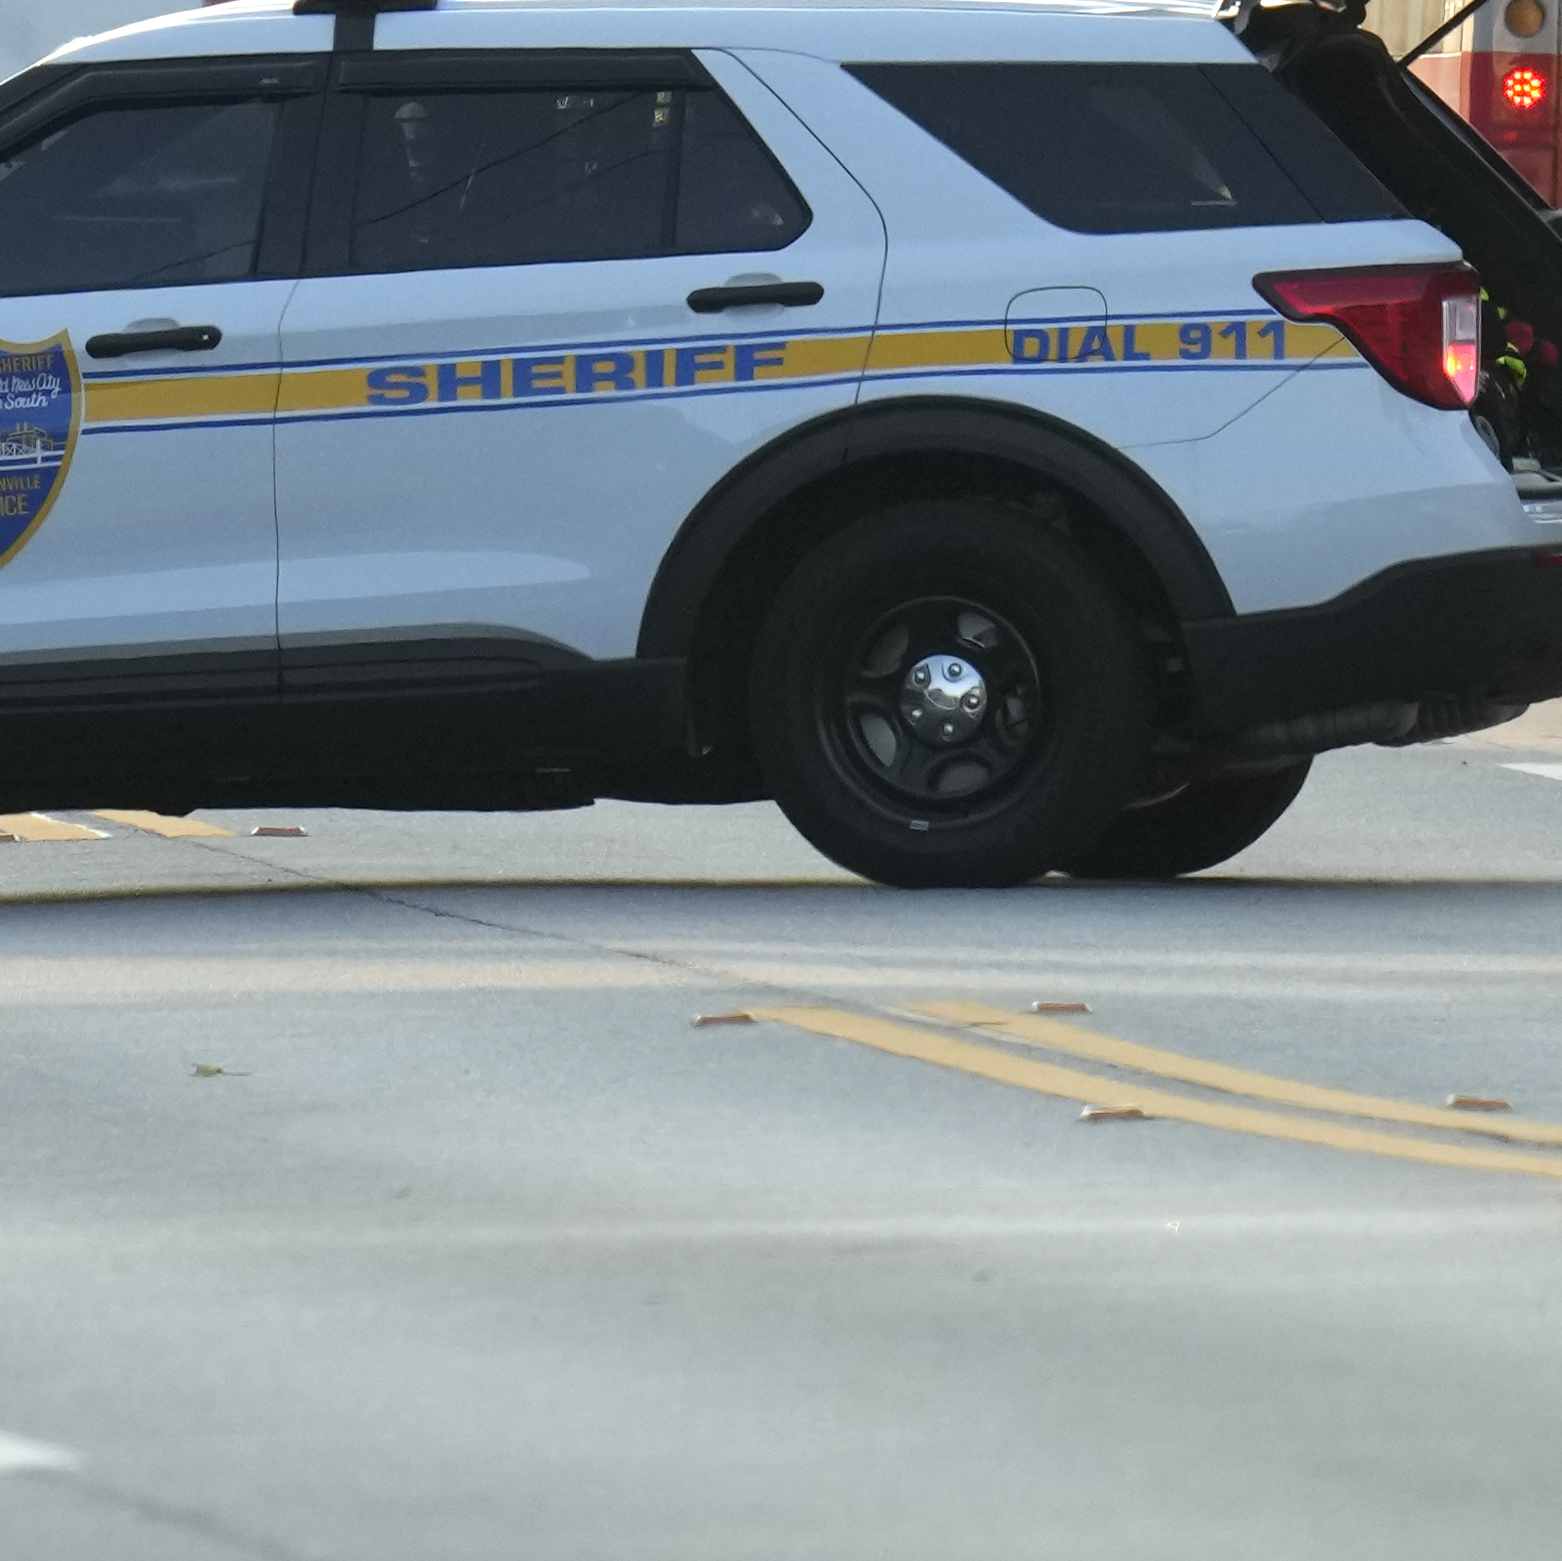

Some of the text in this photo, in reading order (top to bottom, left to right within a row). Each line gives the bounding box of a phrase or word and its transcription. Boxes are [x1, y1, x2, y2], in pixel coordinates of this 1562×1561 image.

[1012, 320, 1286, 365] DIAL 911
[36, 372, 62, 399] City
[365, 341, 788, 406] SHERIFF
[4, 392, 49, 411] South
